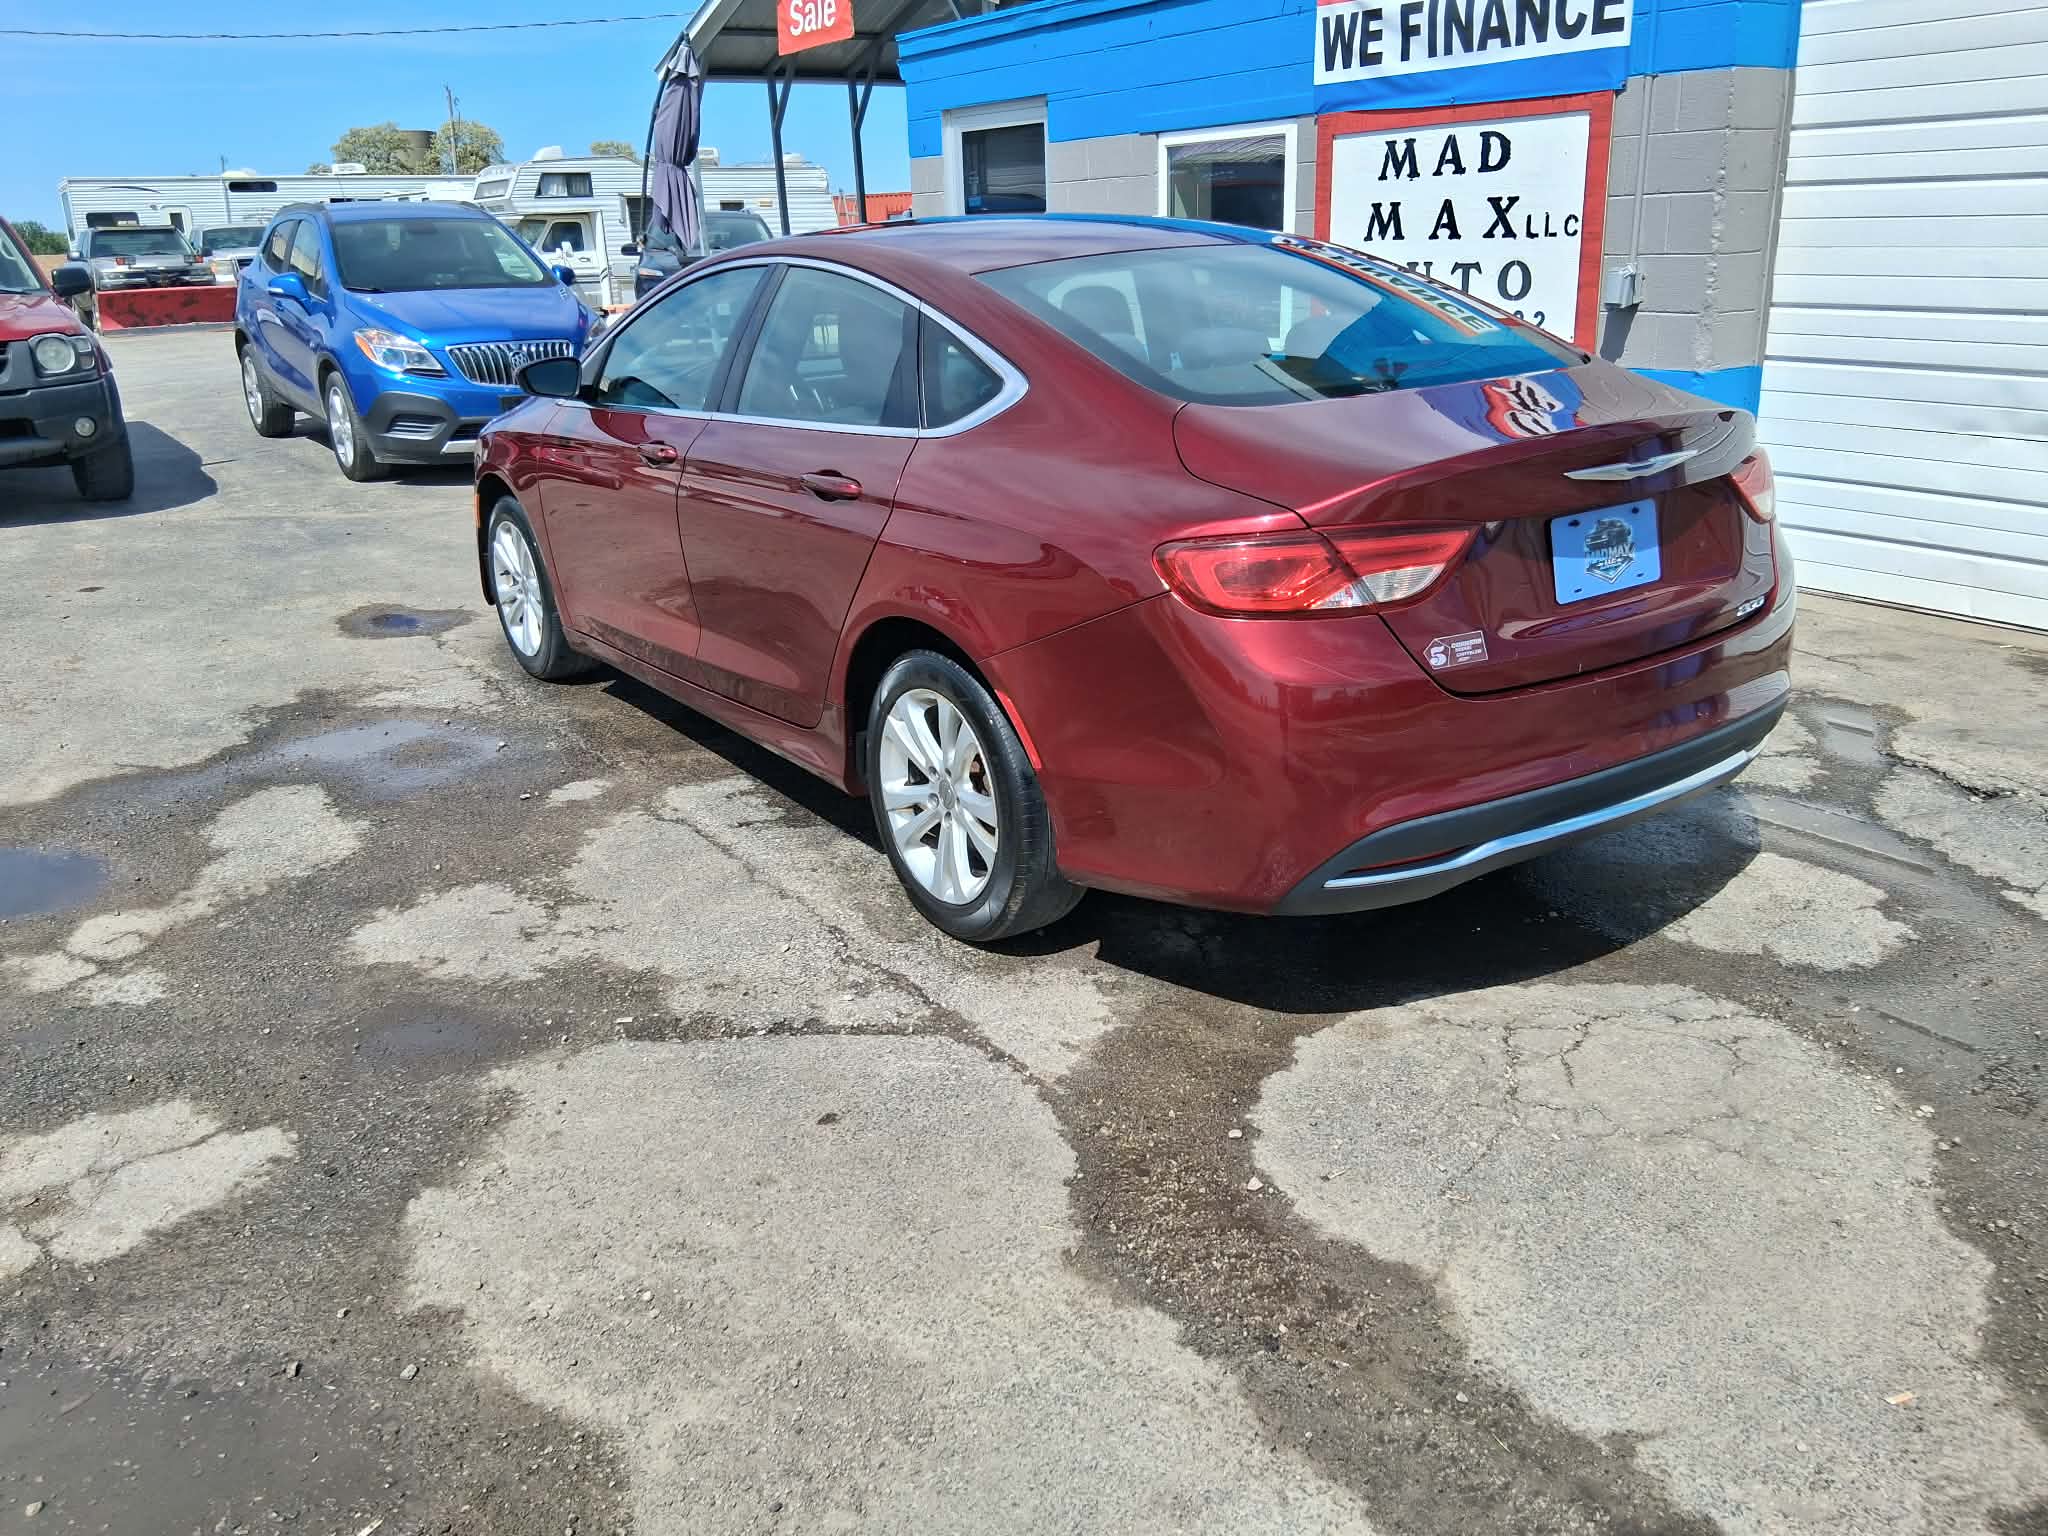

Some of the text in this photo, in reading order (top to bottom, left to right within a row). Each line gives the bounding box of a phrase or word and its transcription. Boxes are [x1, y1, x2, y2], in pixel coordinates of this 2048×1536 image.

[789, 0, 836, 36] Sale
[1322, 0, 1625, 72] WE FINANCE
[1378, 131, 1512, 181] MAD
[1364, 196, 1578, 242] MAX LLC
